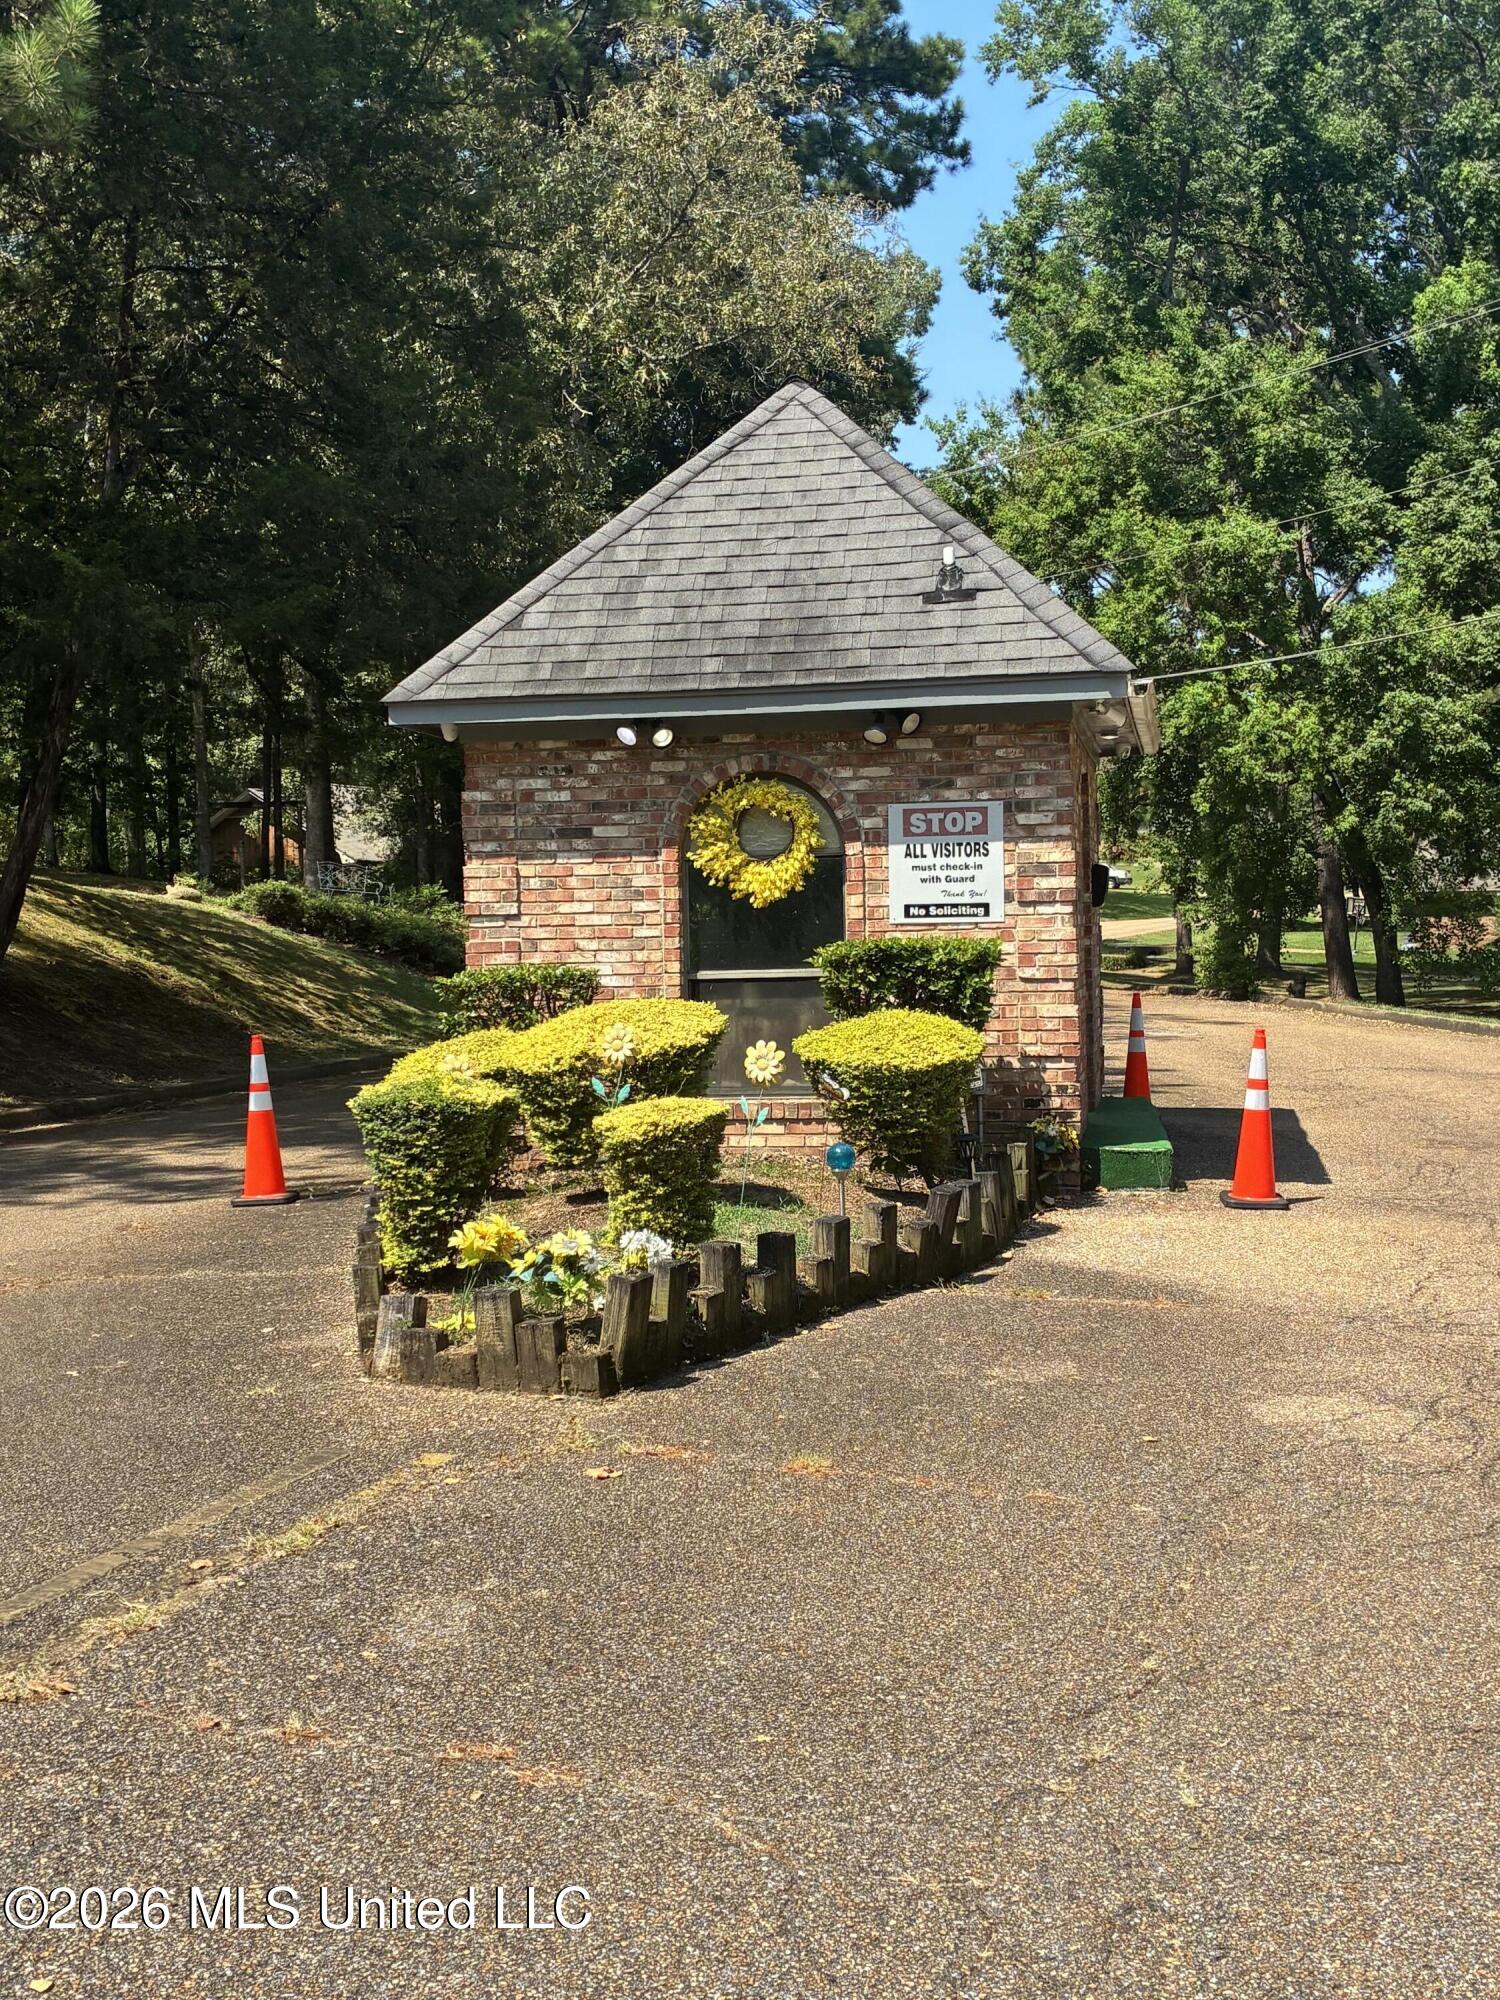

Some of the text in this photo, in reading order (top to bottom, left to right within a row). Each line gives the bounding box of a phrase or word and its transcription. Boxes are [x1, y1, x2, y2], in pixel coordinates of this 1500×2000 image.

[910, 812, 983, 833] STOP
[904, 841, 990, 859] ALL VISITORS
[911, 862, 983, 872] must check-in
[920, 874, 975, 884] with Guard
[940, 889, 988, 899] Thank You!
[909, 905, 985, 916] No Soliciting
